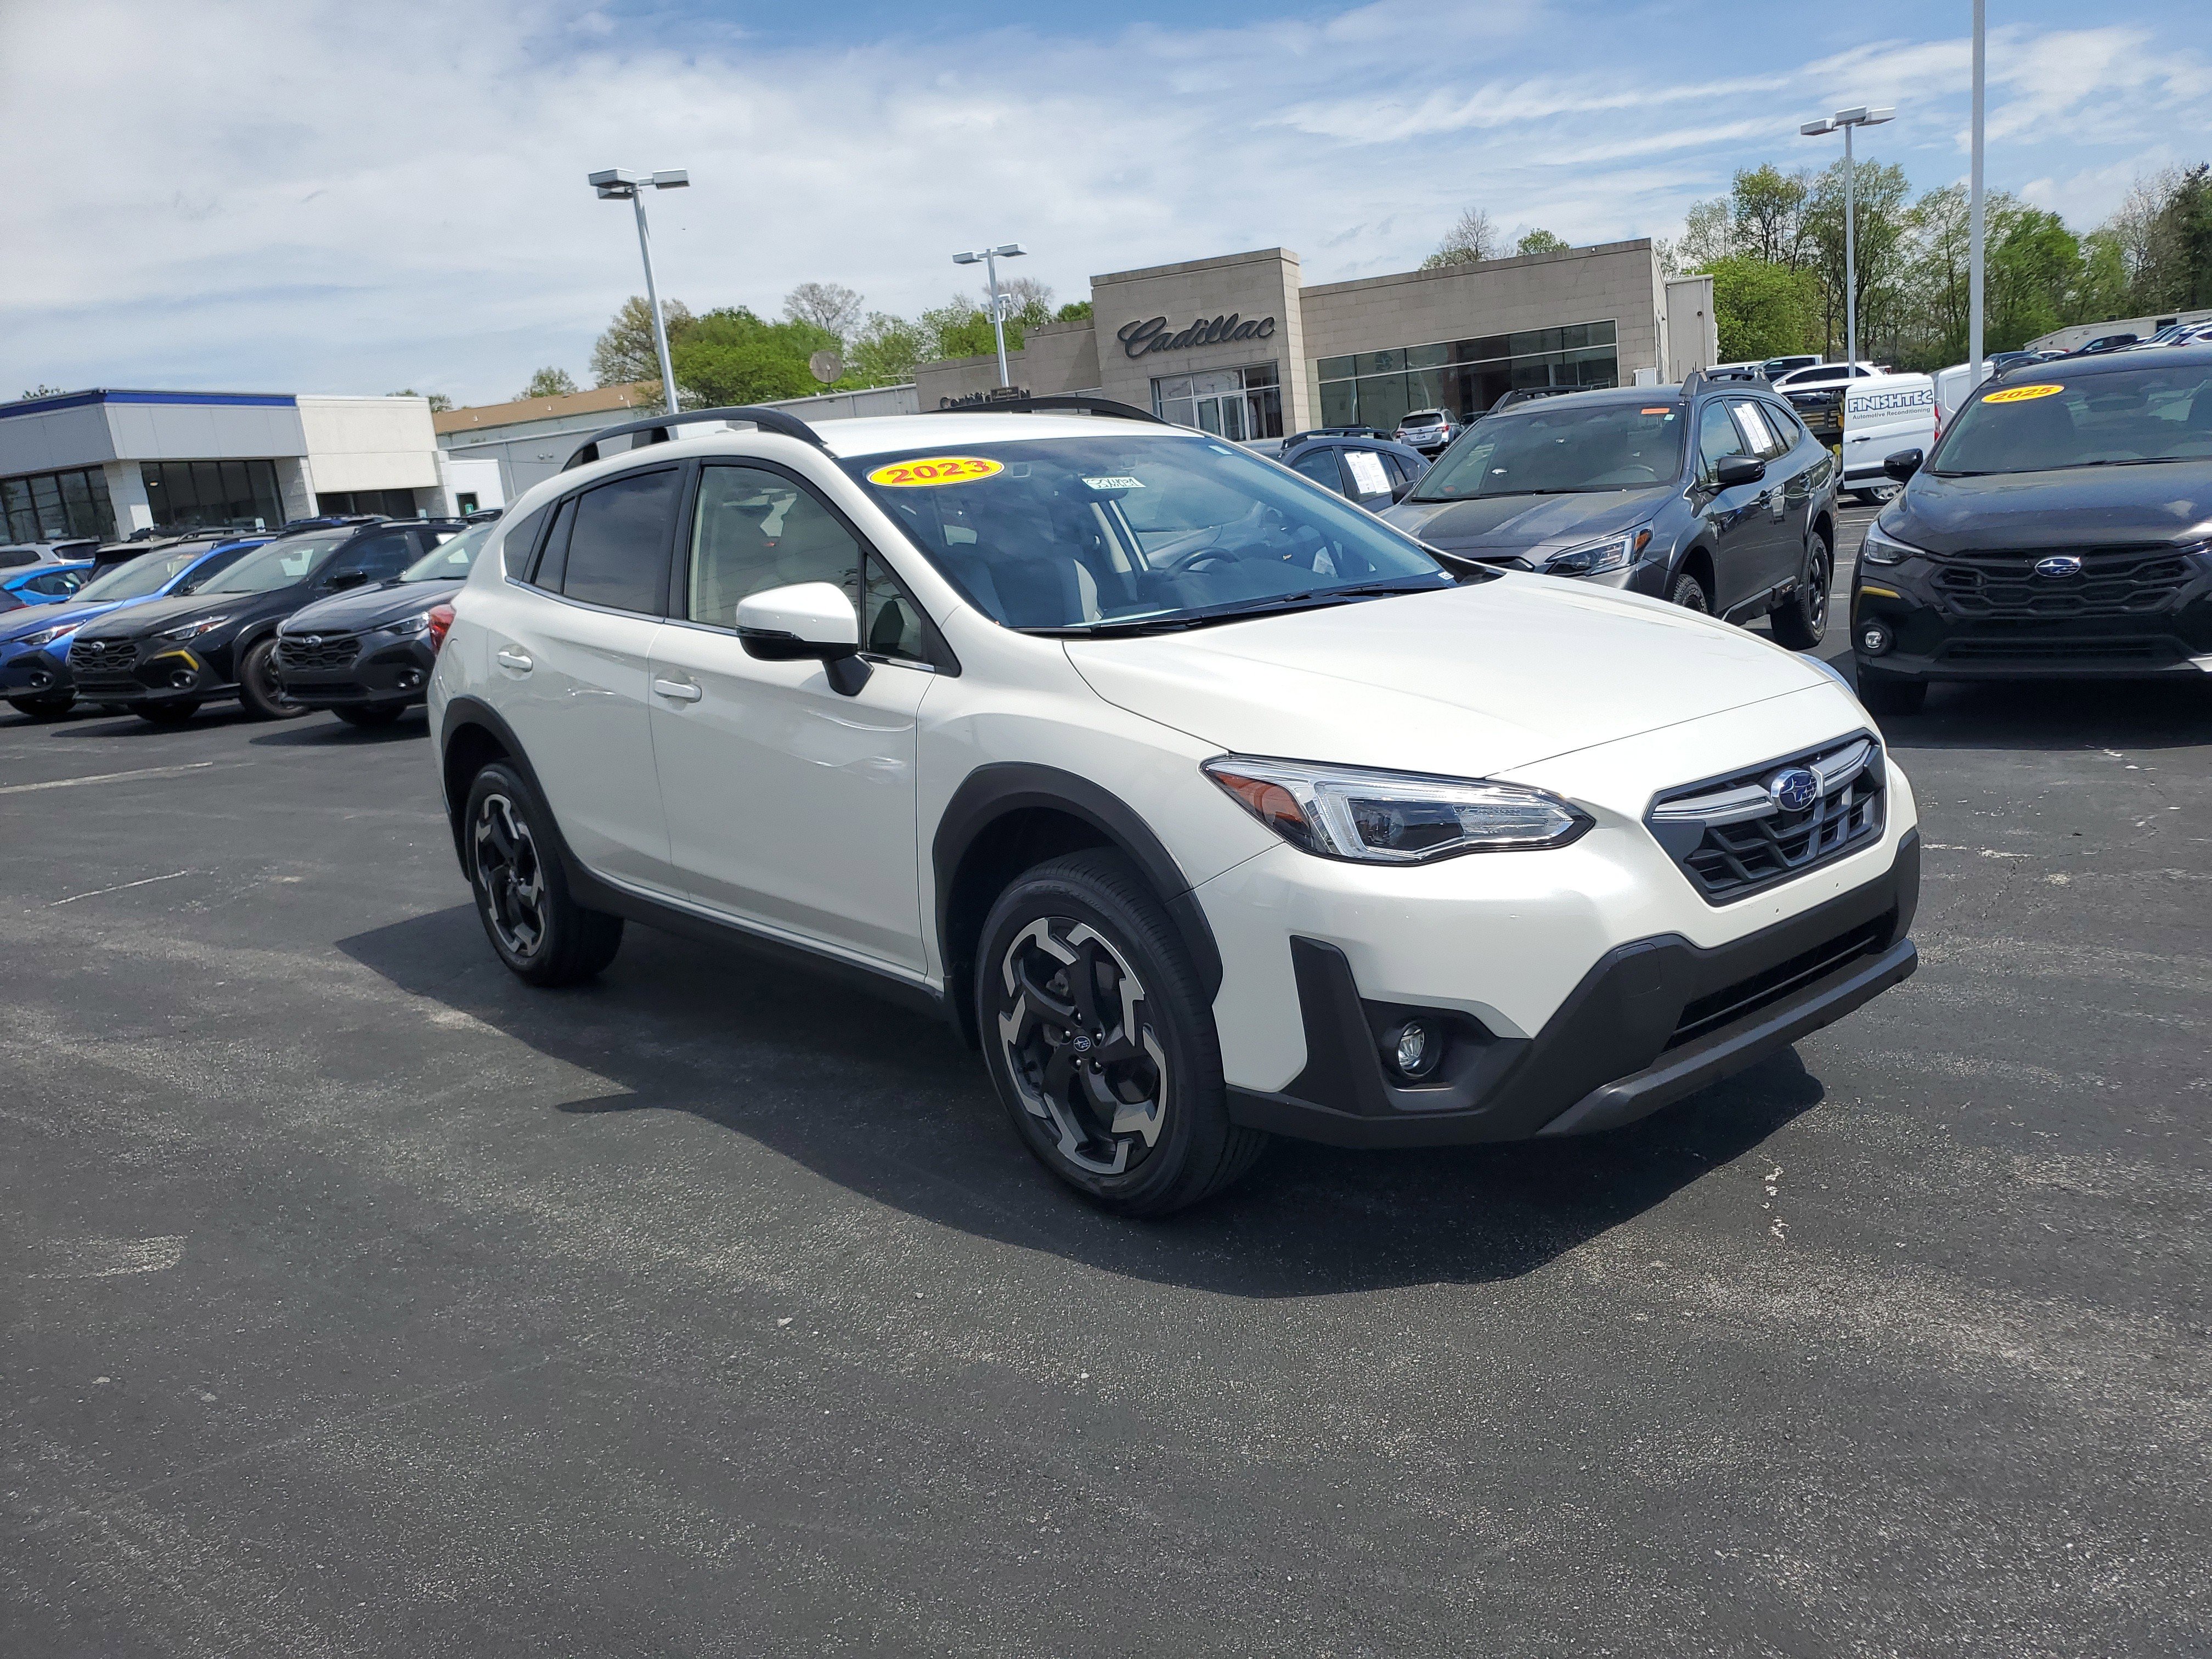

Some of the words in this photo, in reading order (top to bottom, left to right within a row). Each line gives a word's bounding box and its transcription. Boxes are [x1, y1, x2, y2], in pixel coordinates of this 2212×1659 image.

[1117, 313, 1276, 358] Cadillac
[1848, 389, 1933, 413] FINISHTEC
[1990, 386, 2056, 401] 2025
[1887, 407, 1931, 416] Reconditioning
[887, 460, 992, 484] 2023
